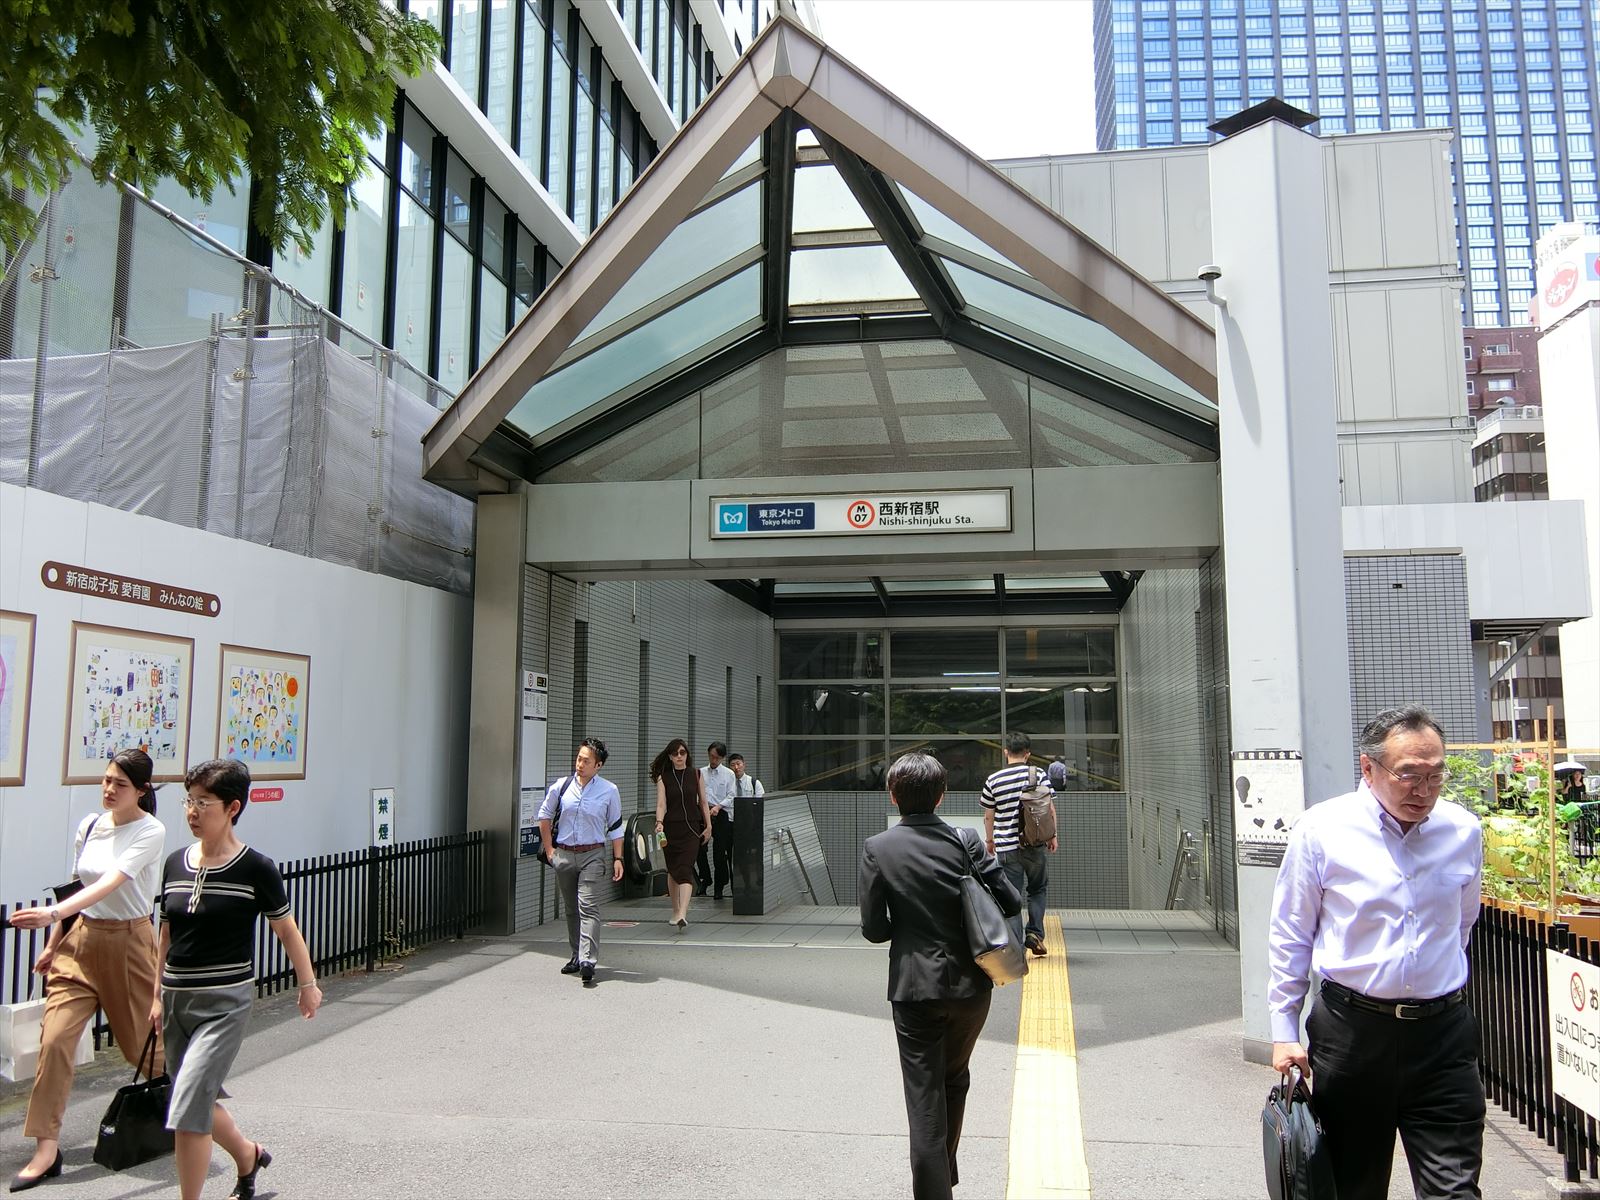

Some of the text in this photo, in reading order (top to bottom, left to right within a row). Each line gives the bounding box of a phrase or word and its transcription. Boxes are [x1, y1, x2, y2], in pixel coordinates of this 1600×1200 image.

[759, 508, 804, 518] 東京メトロ
[856, 505, 866, 513] M
[879, 501, 939, 515] 西新宿駅
[761, 518, 801, 527] Tokyo Metro
[854, 513, 867, 523] 07
[879, 515, 974, 527] Nishi-shinjuku Sta.
[66, 571, 204, 611] 新宿成子坂 愛育園 みんなの絵
[378, 797, 389, 840] 禁煙
